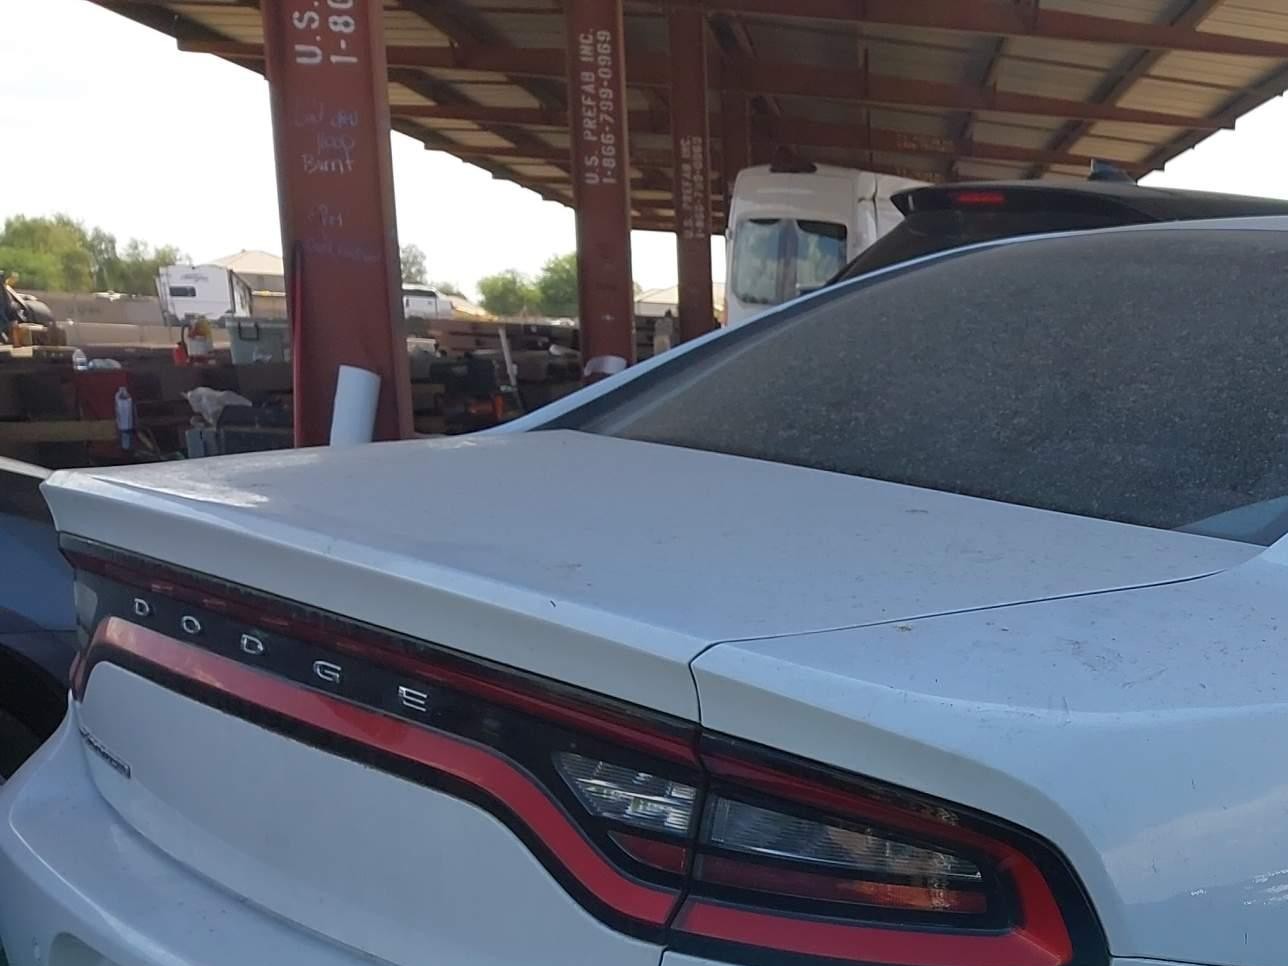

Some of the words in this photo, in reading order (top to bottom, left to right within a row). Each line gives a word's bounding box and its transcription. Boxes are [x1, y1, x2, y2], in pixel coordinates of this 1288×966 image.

[579, 28, 595, 63] INC.
[580, 71, 598, 142] PREFAB
[597, 30, 617, 184] 1-866-799-0969
[584, 150, 600, 184] U.S.
[134, 598, 428, 712] DODGE
